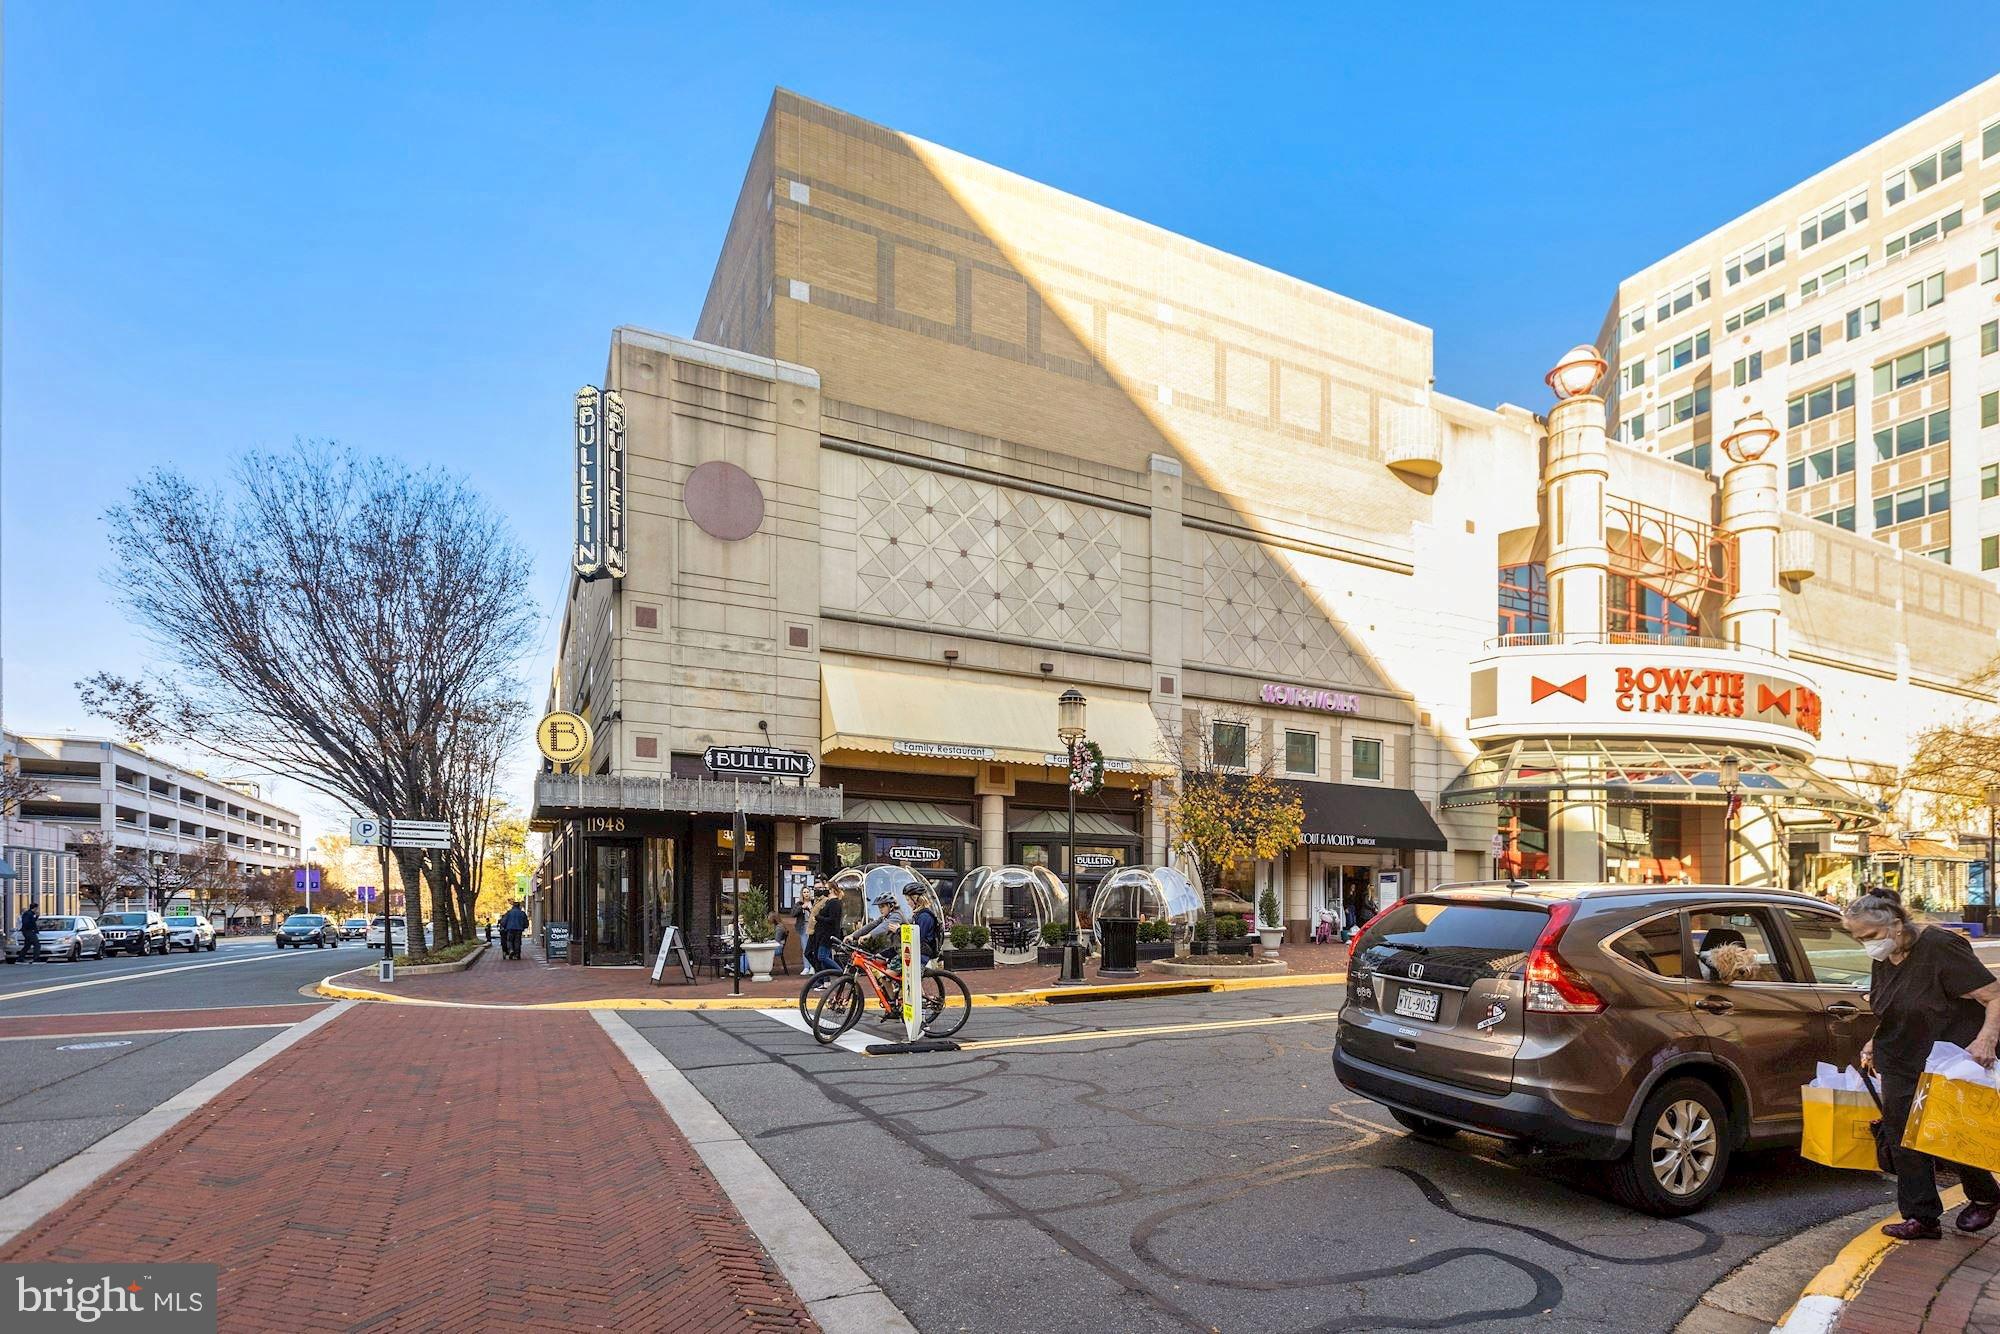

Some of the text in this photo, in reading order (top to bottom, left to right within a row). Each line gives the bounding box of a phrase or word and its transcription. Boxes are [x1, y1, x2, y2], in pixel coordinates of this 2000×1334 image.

[579, 406, 596, 562] BULLETIN
[608, 413, 624, 568] BULLETIN
[1616, 693, 1744, 717] CINEMAS
[548, 721, 579, 751] B
[904, 742, 985, 756] Family Restaurant
[716, 752, 804, 772] BULLETIN
[1053, 754, 1070, 764] Fam
[362, 823, 373, 834] P
[587, 816, 625, 832] 11948
[1320, 833, 1326, 844] &
[894, 849, 936, 859] BULLETIN
[1076, 856, 1112, 865] BULLETIN
